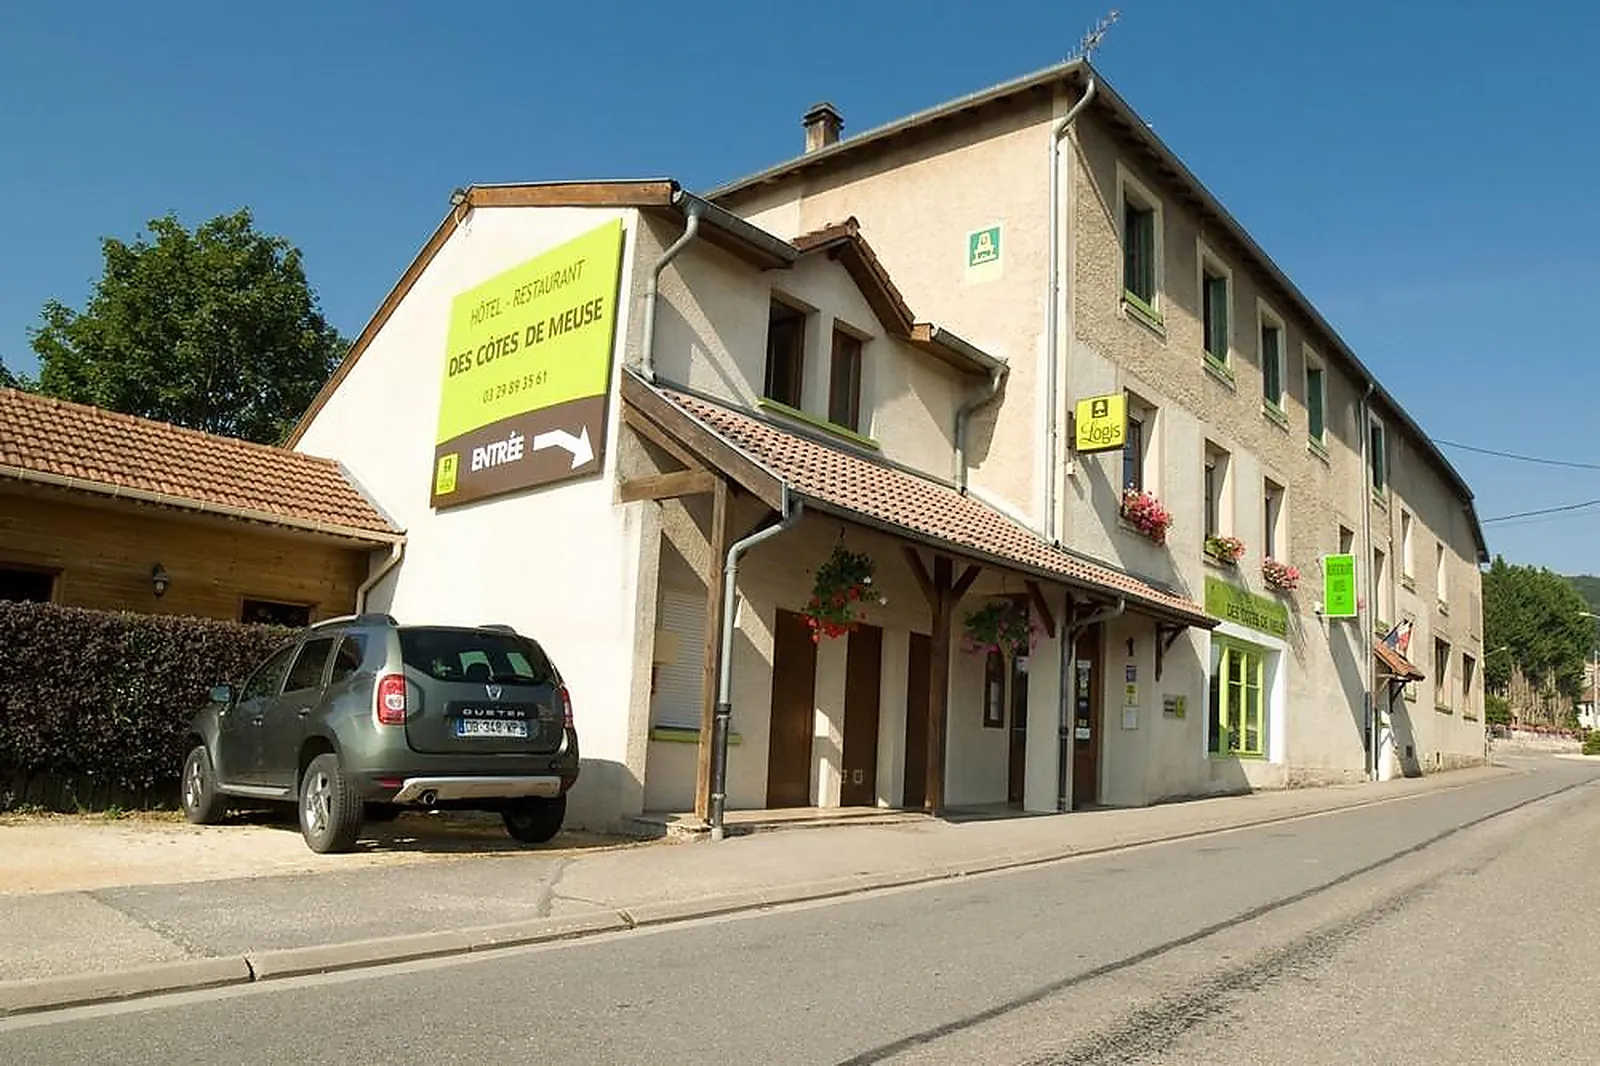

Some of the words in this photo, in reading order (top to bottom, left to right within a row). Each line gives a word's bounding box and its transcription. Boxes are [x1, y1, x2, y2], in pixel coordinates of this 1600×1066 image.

[470, 298, 502, 328] HÔTEL
[513, 259, 586, 307] RESTAURANT
[448, 350, 473, 378] DES
[476, 335, 520, 367] CÔTES
[525, 320, 545, 348] DE
[548, 297, 604, 339] MEUSE
[471, 429, 525, 472] ENTRÉE
[1079, 420, 1121, 444] Logis
[462, 708, 526, 718] DUSTER
